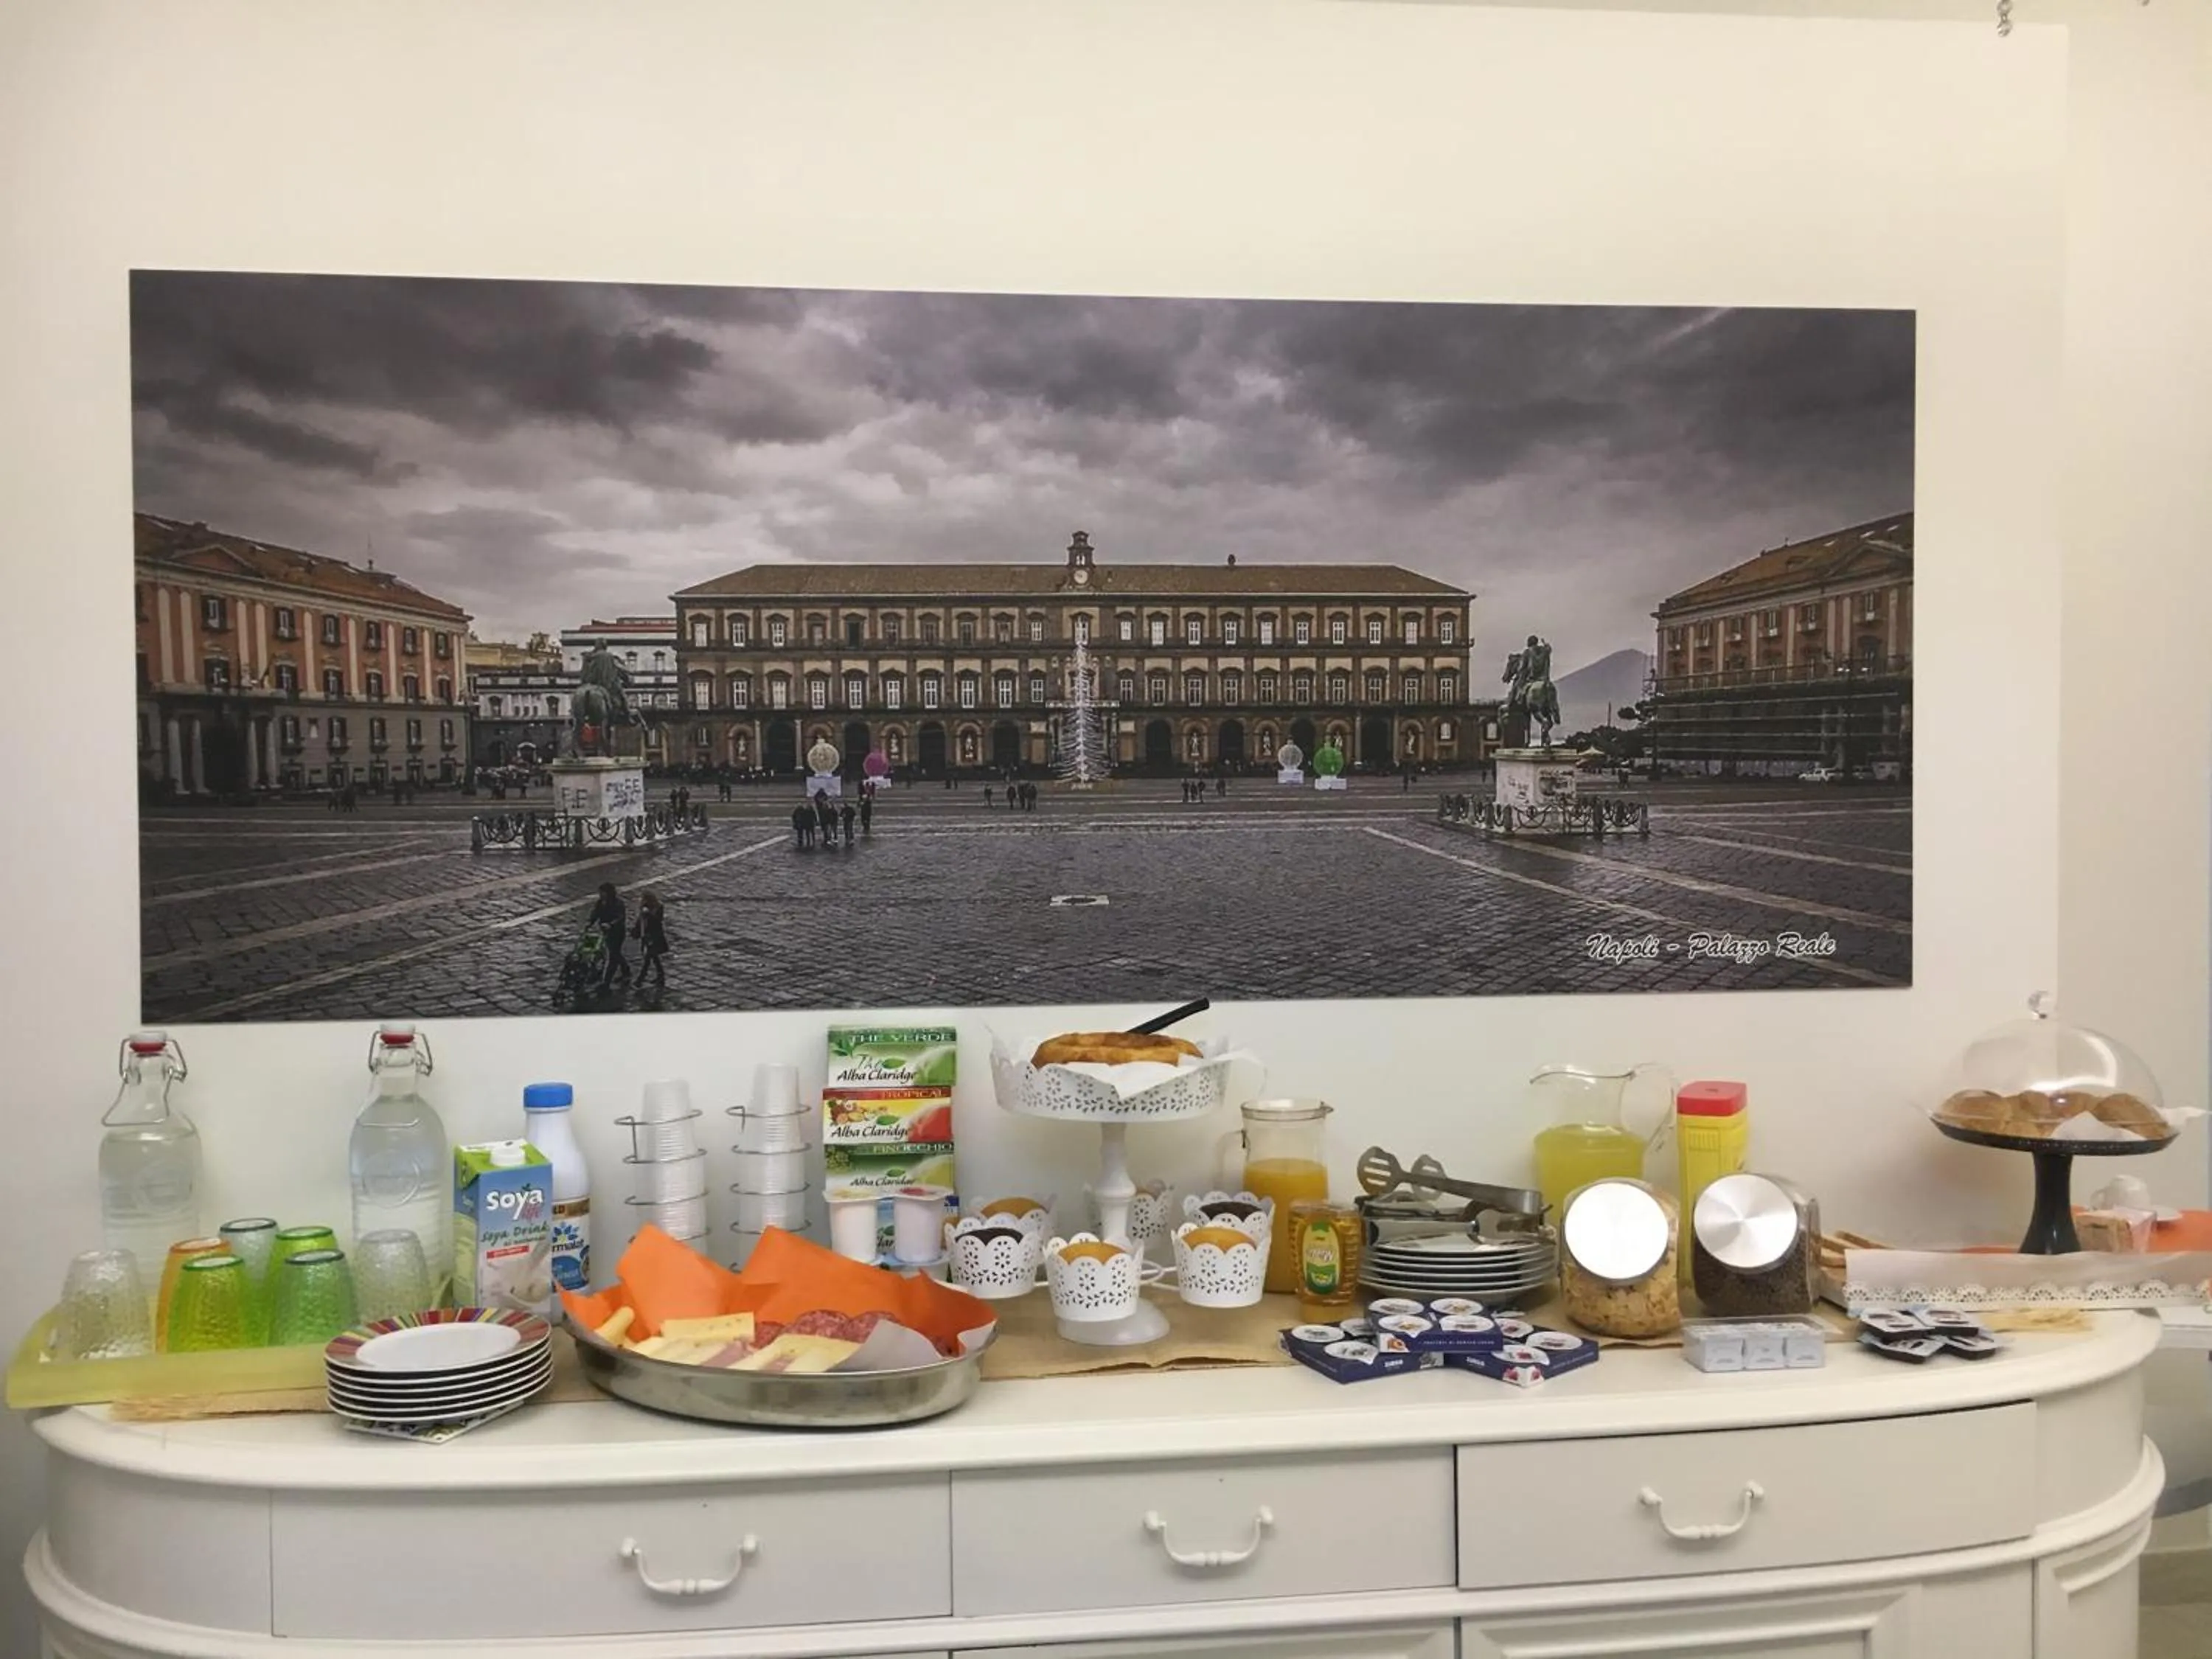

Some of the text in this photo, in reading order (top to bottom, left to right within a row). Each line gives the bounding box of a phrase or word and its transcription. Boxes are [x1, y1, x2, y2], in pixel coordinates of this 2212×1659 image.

[1586, 932, 1660, 963] Napoli
[1688, 932, 1770, 963] Palazzo
[1775, 931, 1837, 957] Reale
[891, 1032, 952, 1042] VERDE
[837, 1069, 866, 1082] Alba
[881, 1089, 945, 1099] TROPICAL
[831, 1126, 860, 1138] Alba
[873, 1143, 953, 1154] FINOCCHIO
[850, 1177, 874, 1187] Alba
[552, 1238, 584, 1252] rmalat
